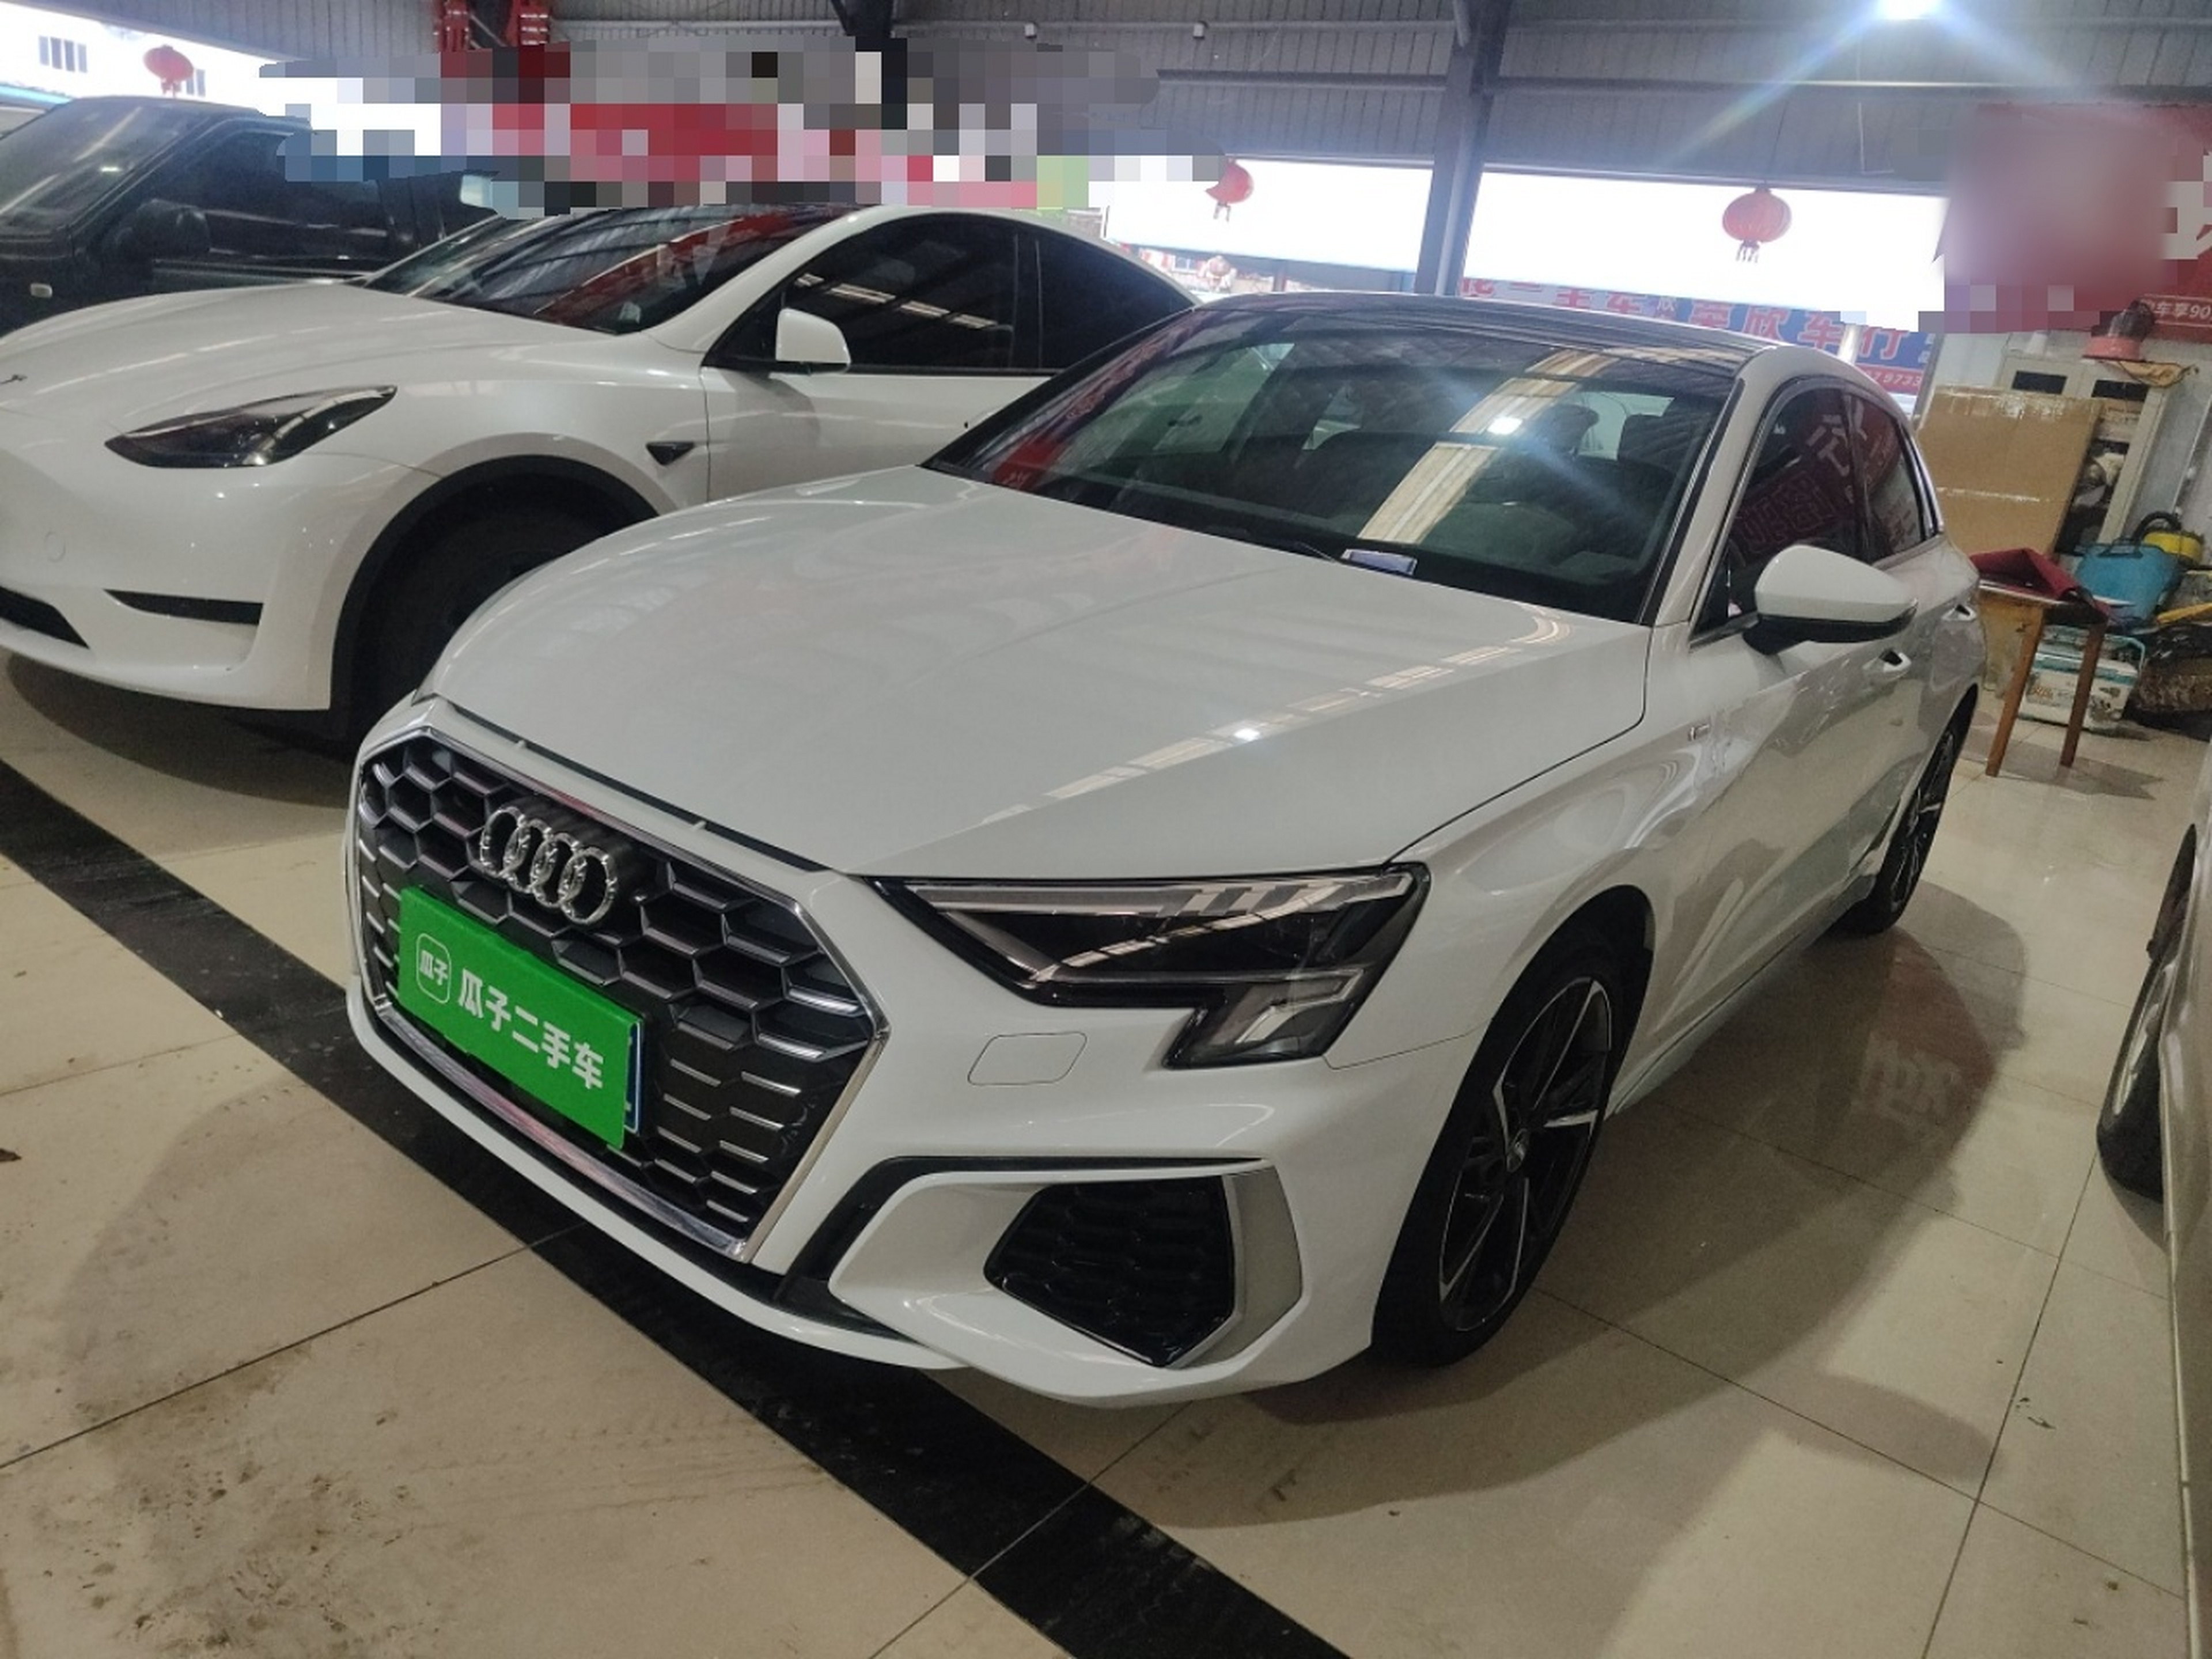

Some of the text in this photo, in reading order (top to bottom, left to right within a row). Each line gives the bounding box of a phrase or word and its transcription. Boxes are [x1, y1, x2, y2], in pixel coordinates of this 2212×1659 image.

[419, 948, 449, 986] 瓜子
[458, 968, 604, 1090] 瓜子二手车
